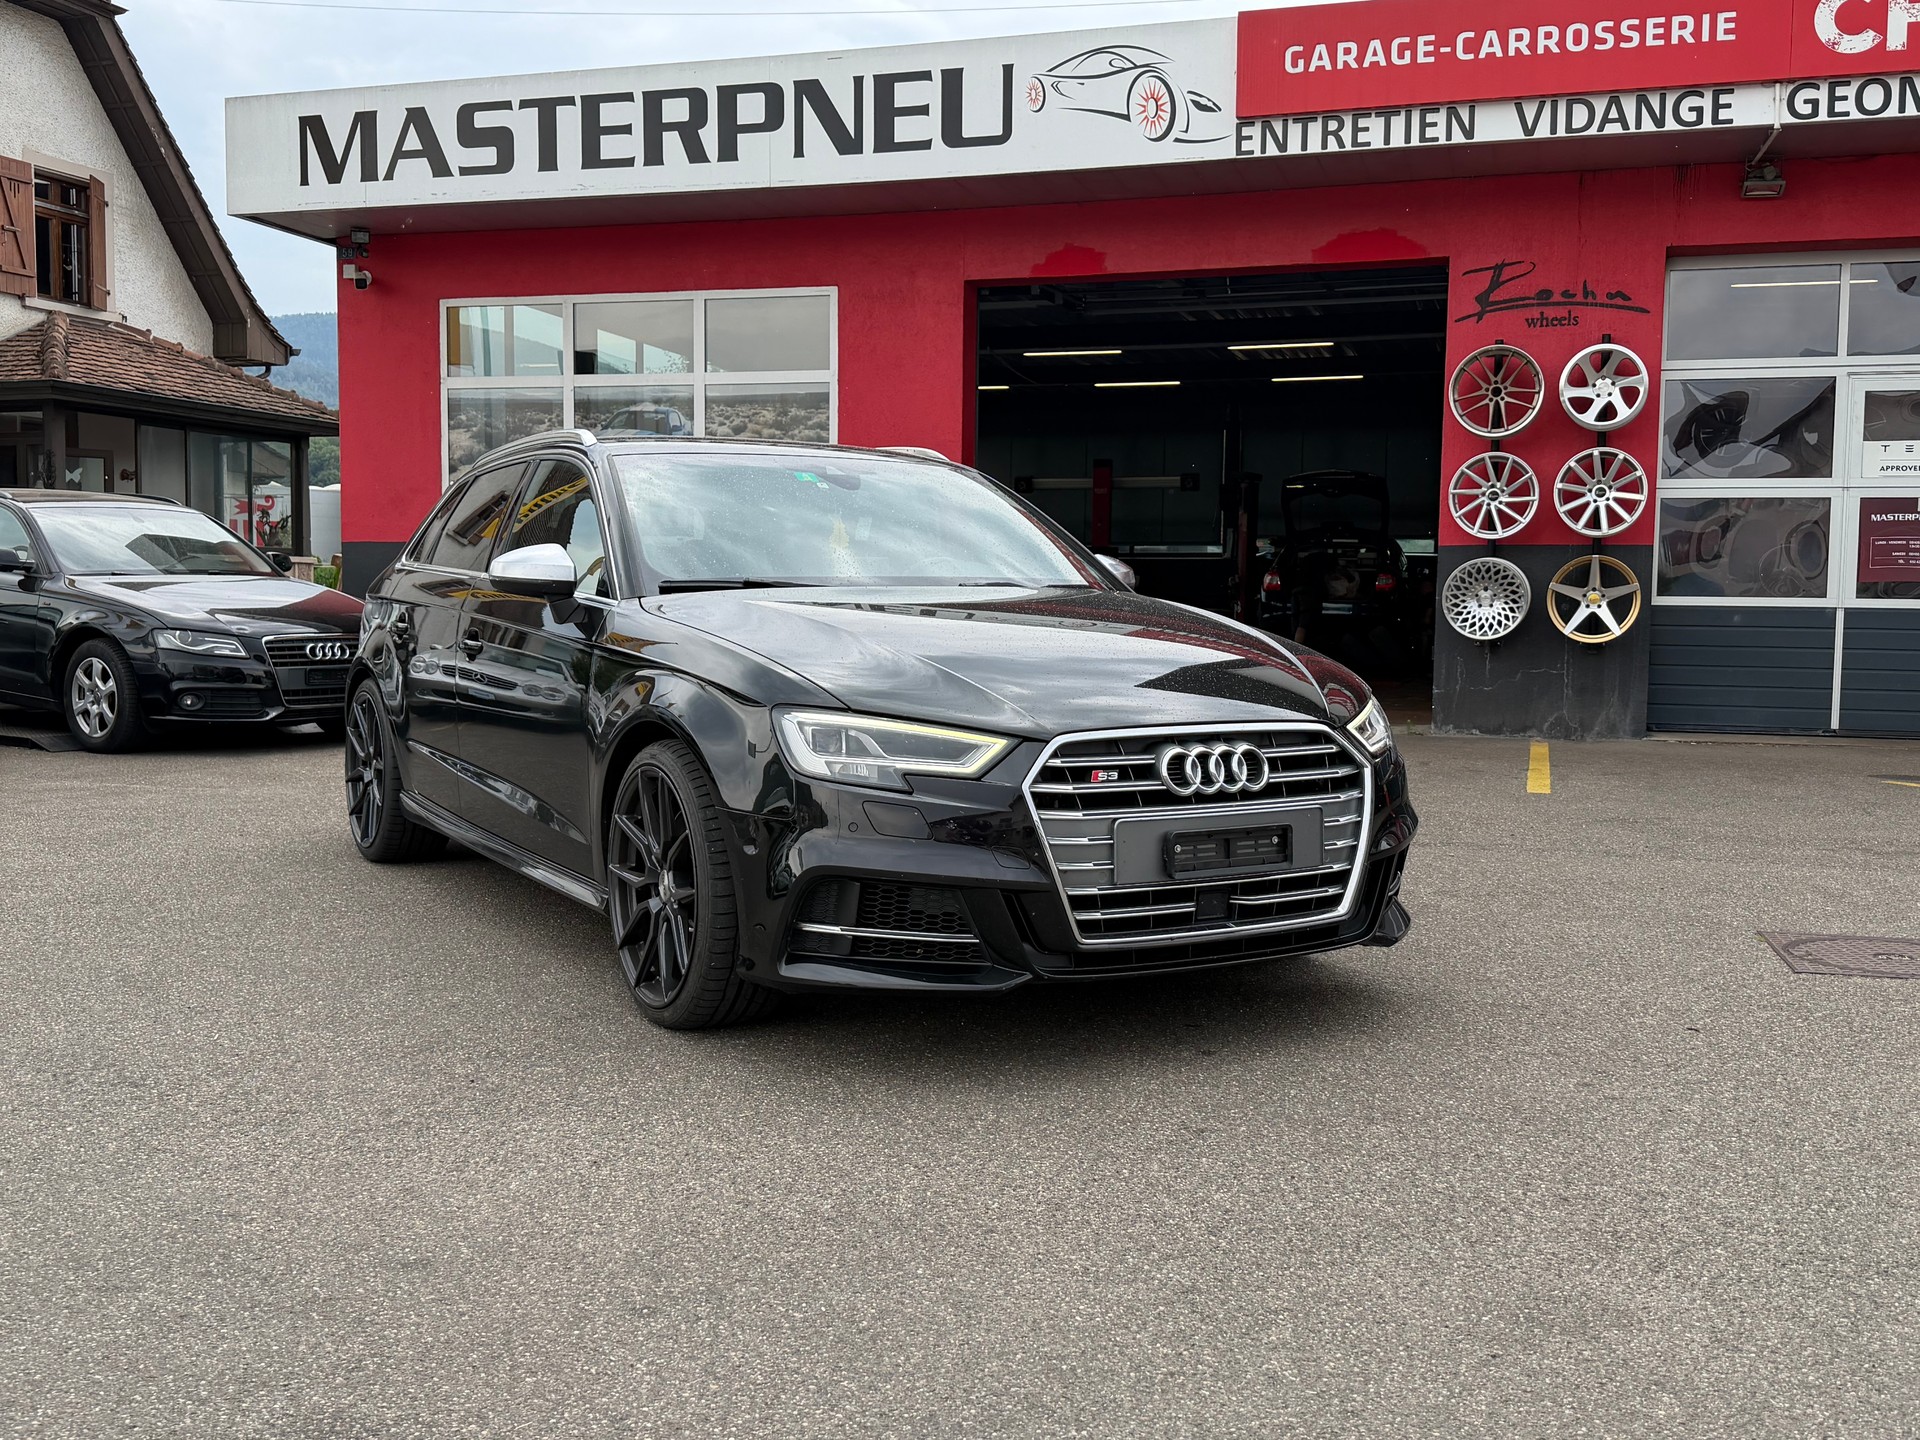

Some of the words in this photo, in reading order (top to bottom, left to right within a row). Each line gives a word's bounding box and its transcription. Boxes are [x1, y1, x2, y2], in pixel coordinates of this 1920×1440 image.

[1284, 11, 1738, 74] GARAGE-CARROSSERIE
[299, 63, 1014, 187] MASTERPNEU
[1236, 104, 1477, 157] ENTRETIEN
[1514, 88, 1735, 136] VIDANGE
[342, 248, 353, 258] 59
[1525, 310, 1580, 328] wheels
[1870, 513, 1920, 521] MASTERP
[1097, 772, 1118, 780] S3
